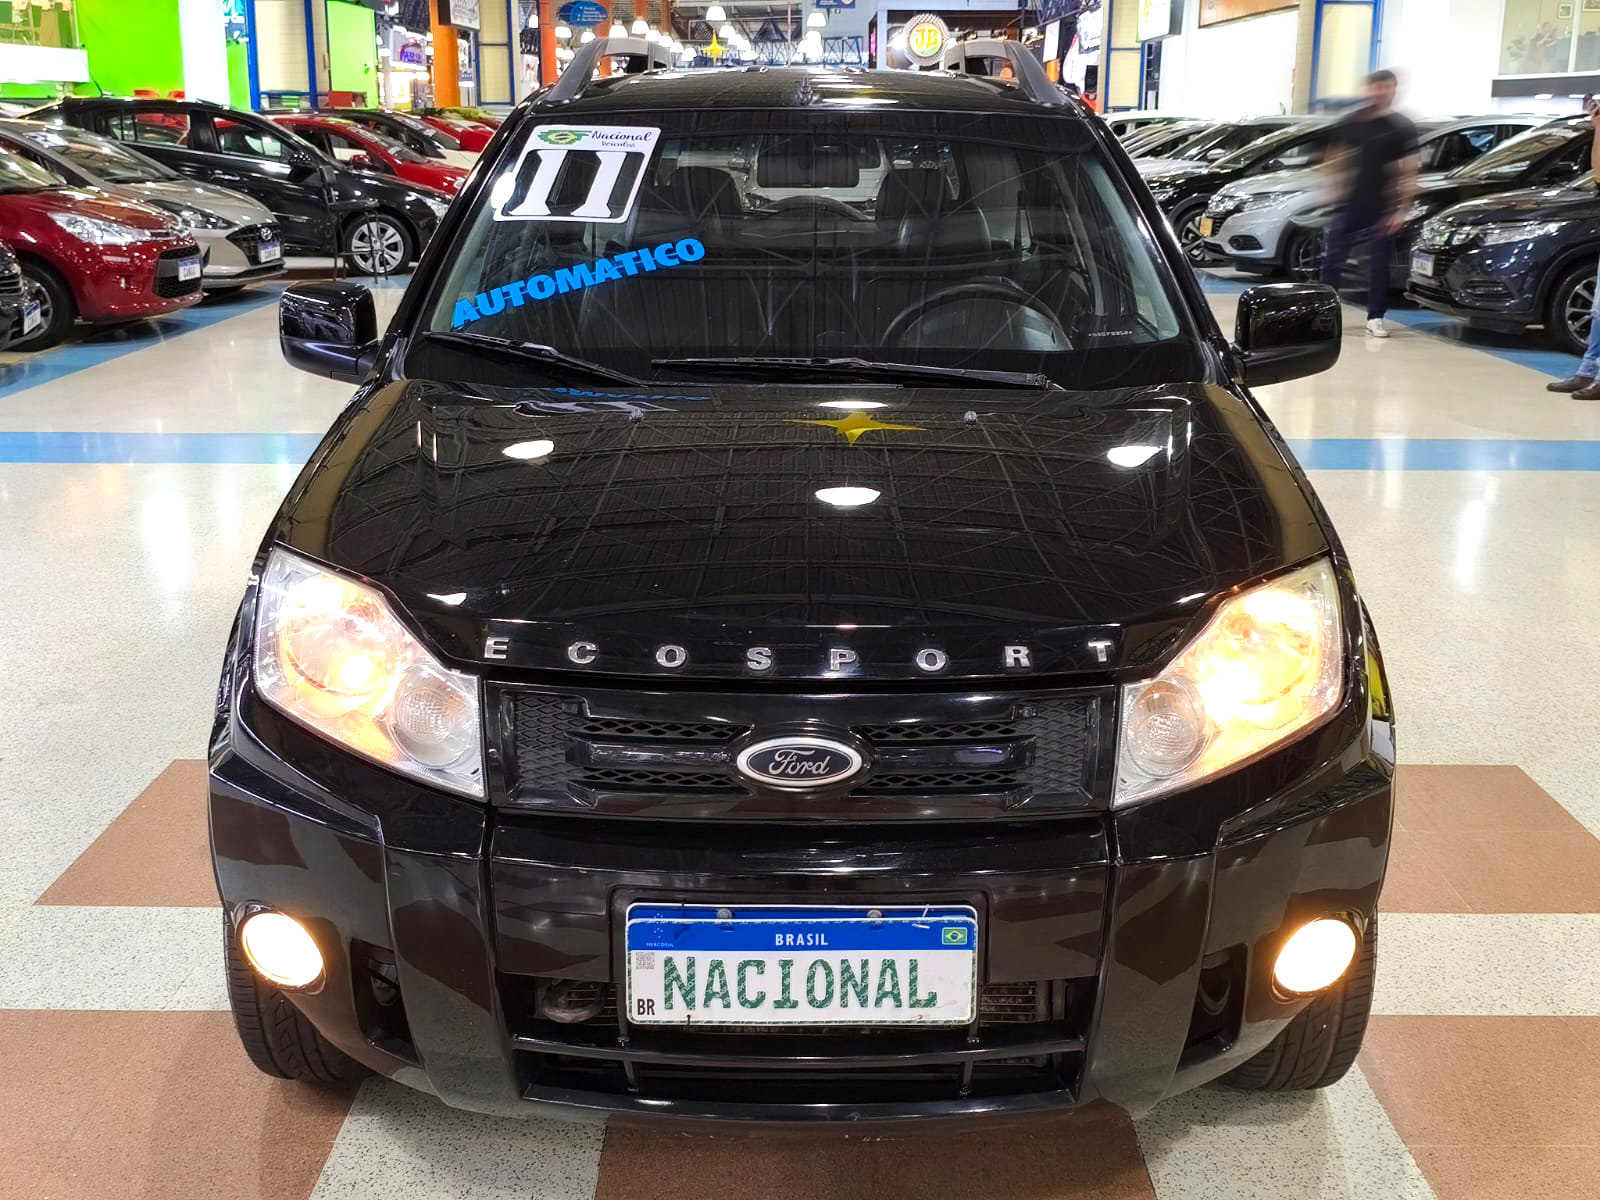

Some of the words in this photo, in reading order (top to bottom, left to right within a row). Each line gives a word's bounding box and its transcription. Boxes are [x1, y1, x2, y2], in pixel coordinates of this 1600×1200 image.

[592, 130, 652, 142] Nacional
[453, 238, 706, 328] AUTOMATICO
[484, 636, 1112, 672] ECOSPORT
[768, 749, 831, 775] Ford
[775, 933, 829, 946] BRASIL
[663, 956, 938, 1011] NACIONAL
[637, 998, 655, 1016] BR
